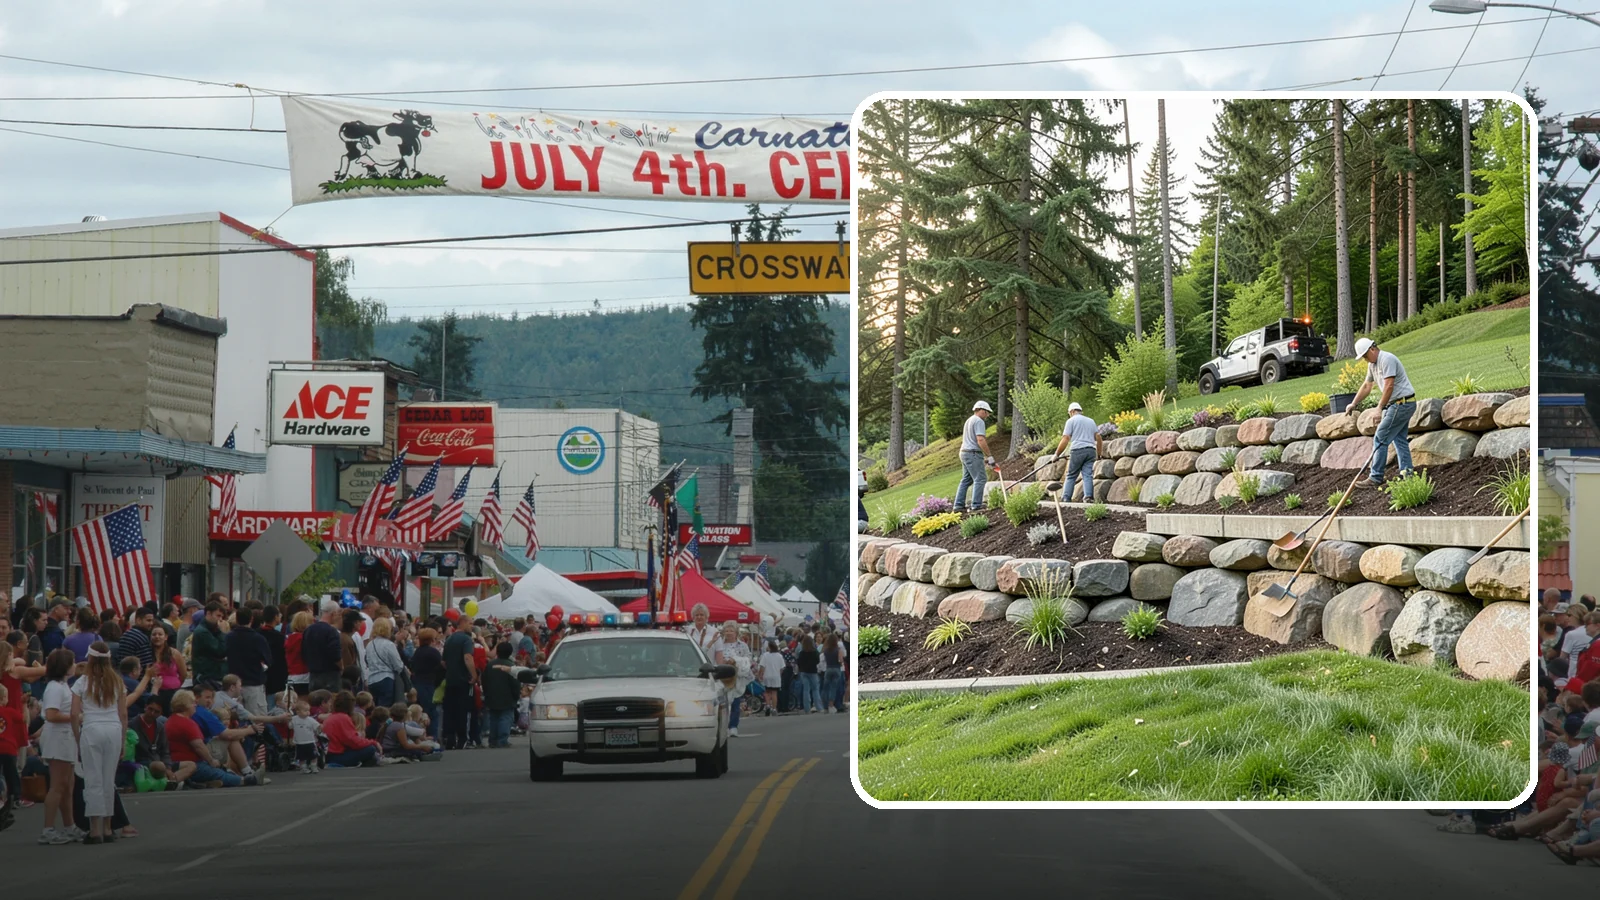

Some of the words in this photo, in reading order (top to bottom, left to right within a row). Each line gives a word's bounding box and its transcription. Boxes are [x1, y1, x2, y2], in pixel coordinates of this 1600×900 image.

[481, 141, 605, 192] JULY
[632, 150, 746, 198] 4th.
[697, 254, 850, 280] CROSSWA
[283, 379, 373, 420] ACE
[405, 408, 452, 422] CEDAR
[283, 421, 370, 437] Hardware
[416, 428, 477, 447] Coca-Cola
[95, 485, 124, 495] Vincent
[126, 485, 135, 494] de
[138, 485, 155, 495] Paul
[81, 502, 154, 522] THT
[688, 526, 741, 535] CRNATION
[699, 535, 730, 543] GLASS
